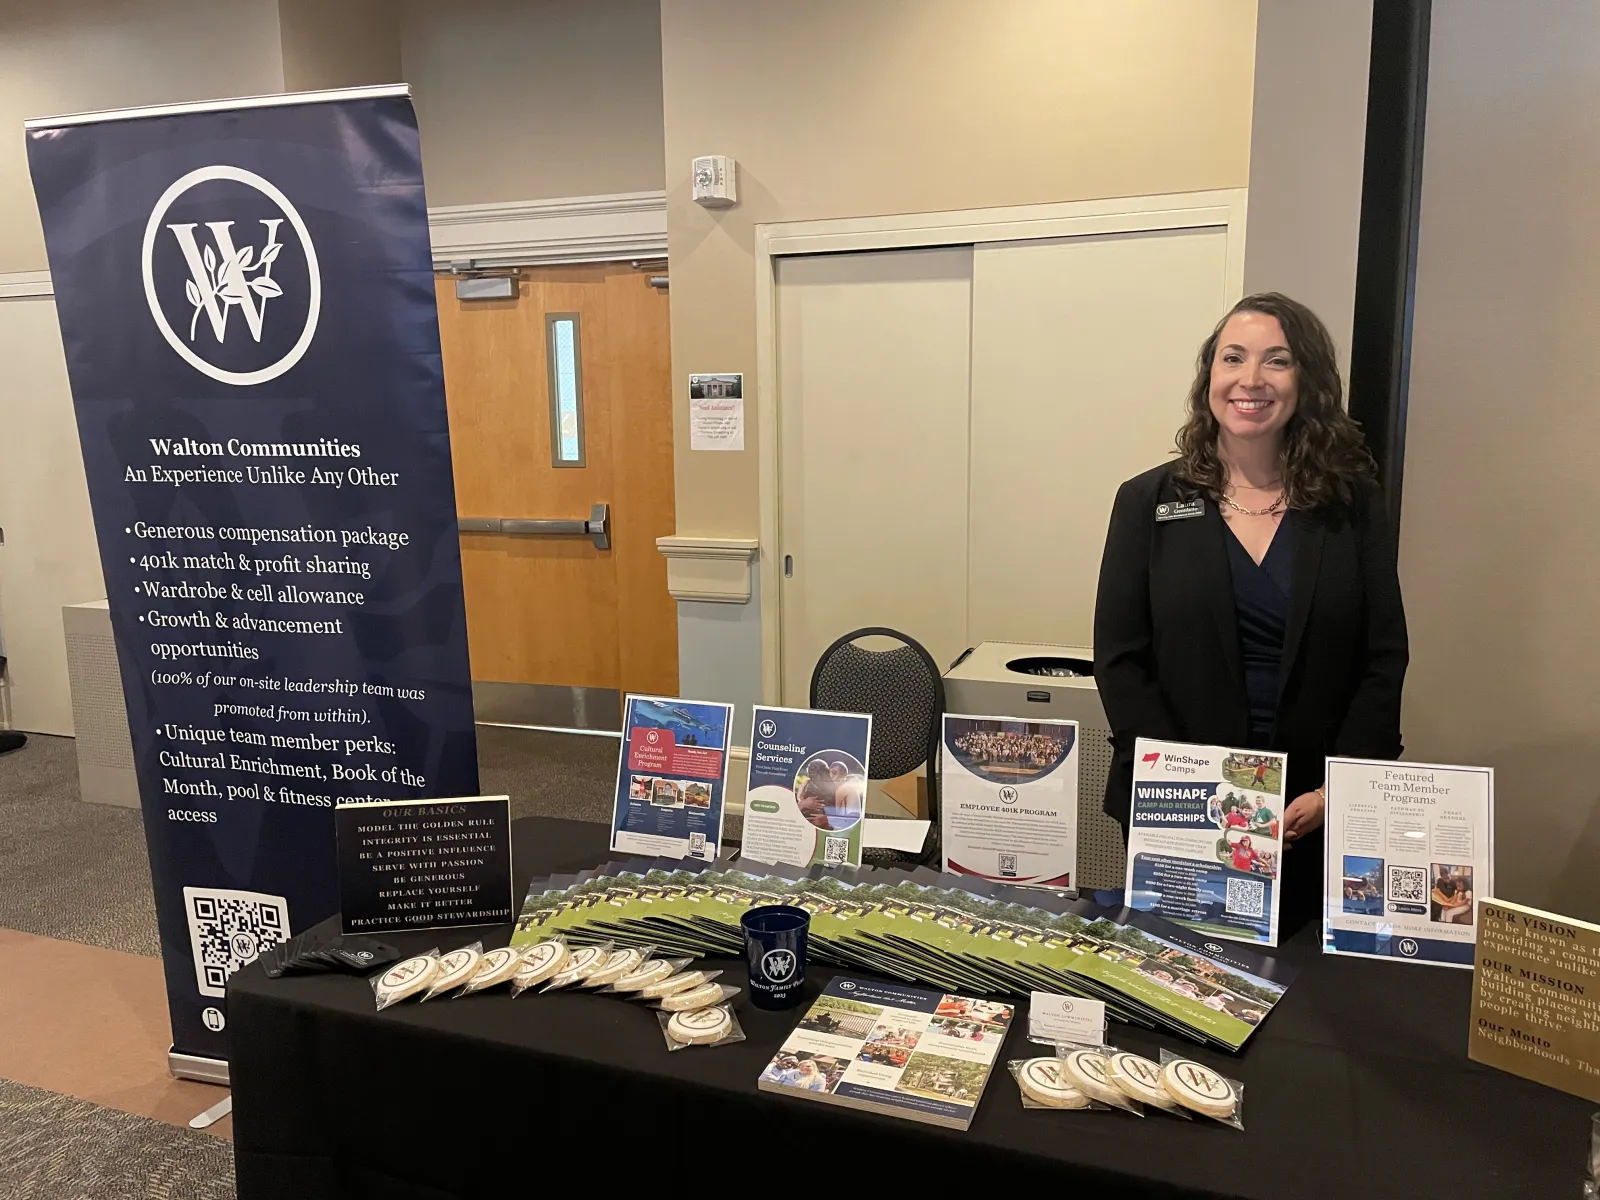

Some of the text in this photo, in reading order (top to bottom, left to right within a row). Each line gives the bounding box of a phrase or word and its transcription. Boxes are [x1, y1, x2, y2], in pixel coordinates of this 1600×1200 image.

[149, 437, 361, 458] Walton Communities
[124, 464, 399, 489] An Experience Unlike Any Other
[134, 521, 410, 551] Generous compensation package
[139, 550, 371, 580] 401k match & profit sharing
[142, 580, 365, 605] Wardrobe & cell allowance
[147, 610, 344, 634] Growth & advancement
[150, 640, 259, 660] opportunities
[151, 669, 425, 700] (100% of our on-site leadership team was
[213, 703, 371, 725] promoted from within).
[164, 723, 396, 756] Unique team member perks:
[757, 741, 806, 754] Counseling
[634, 752, 667, 762] Enrichment
[640, 745, 663, 753] Cultural
[638, 760, 662, 769] Program
[756, 753, 793, 764] Services
[1164, 753, 1210, 766] WinShape
[159, 750, 426, 788] Cultural Enrichment, Book of the
[1165, 764, 1195, 774] Camps
[1384, 770, 1434, 783] Featured
[162, 777, 223, 799] Month,
[226, 783, 260, 801] pool
[263, 785, 276, 802] &
[278, 786, 332, 808] fitness
[1137, 788, 1207, 800] WINSHAPE
[1369, 780, 1450, 795] Team Member
[1137, 801, 1158, 809] CAMP
[1383, 792, 1436, 805] Programs
[168, 809, 218, 823] access
[383, 805, 467, 818] OUR BASICS
[960, 803, 1000, 812] EMPLOYEE
[1020, 808, 1057, 817] PROGRAM
[1135, 812, 1205, 822] SCHOLARSHIPS
[357, 823, 395, 833] MODEL
[398, 823, 419, 831] THE
[423, 820, 464, 829] GOLDEN
[362, 836, 419, 845] INTEGRITY
[437, 832, 492, 841] ESSENTIAL
[387, 849, 435, 858] POSITIVE
[438, 845, 496, 855] INFLUENCE
[372, 859, 484, 872] SERVE WITH PASSION
[410, 873, 465, 883] GENEROUS
[379, 885, 480, 898] REPLACE YOURSELF
[387, 902, 417, 910] MAKE
[435, 898, 473, 907] BETTER
[351, 909, 510, 926] PRACTICE GOOD STEWARDSHIP
[1485, 907, 1577, 939] OUR VISION
[1483, 928, 1544, 954] providing
[1484, 917, 1499, 929] To
[1505, 921, 1519, 934] be
[1525, 928, 1566, 948] known
[1572, 943, 1586, 953] as
[1483, 939, 1597, 977] experience unlike
[1481, 968, 1525, 989] Walton
[1482, 958, 1585, 995] OUR MISSION
[884, 990, 928, 1000] COMMUNITIES
[1481, 977, 1532, 1002] building
[1537, 993, 1577, 1014] places
[1480, 988, 1494, 1000] by
[1499, 995, 1550, 1020] creating
[1479, 998, 1567, 1033] people thrive.
[1478, 1018, 1551, 1048] Our Motto
[1477, 1027, 1570, 1065] Neighborhoods
